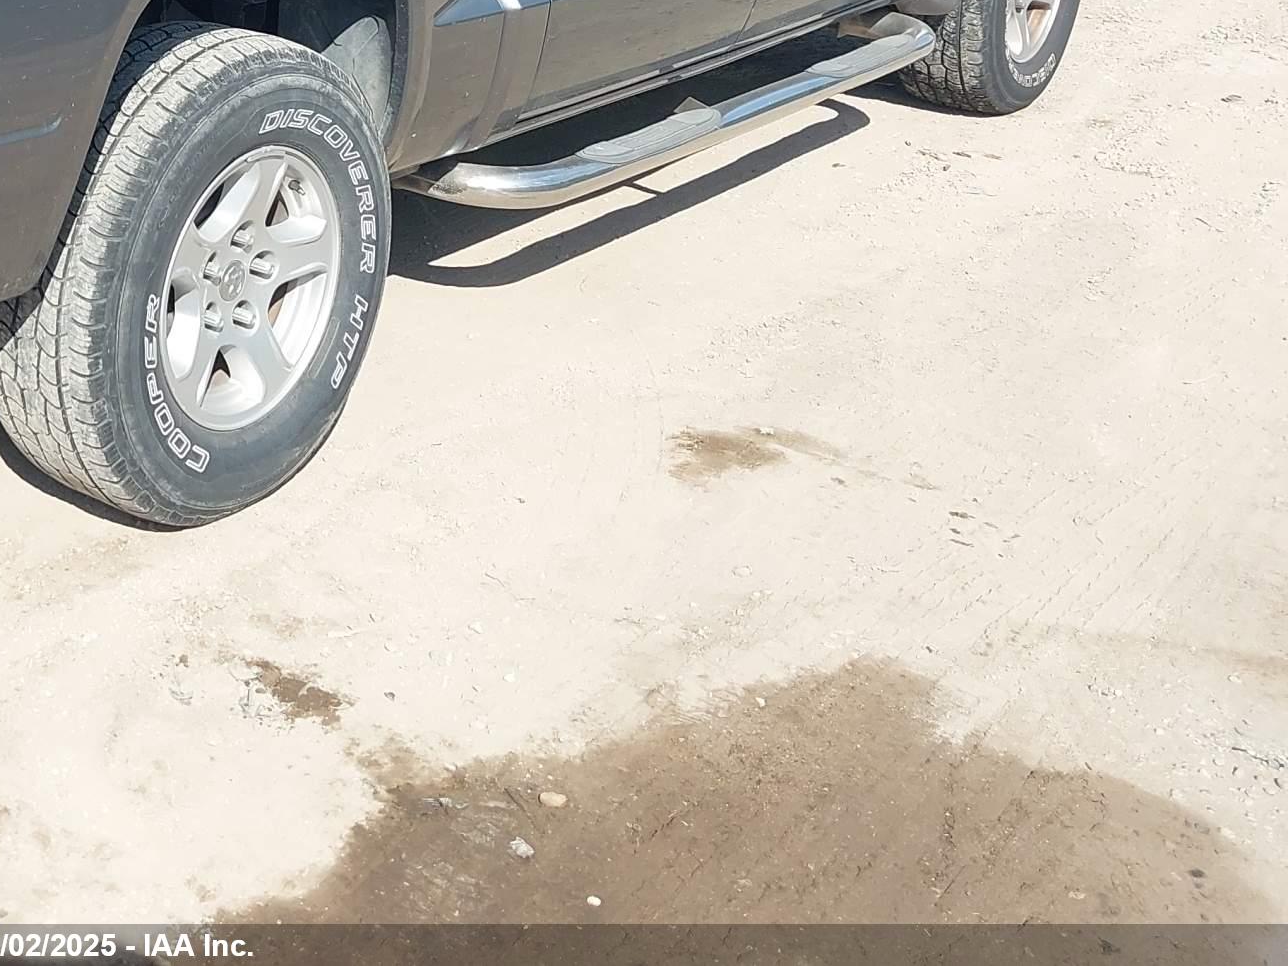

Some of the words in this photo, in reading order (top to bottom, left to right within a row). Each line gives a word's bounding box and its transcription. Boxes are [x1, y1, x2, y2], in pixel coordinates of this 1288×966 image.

[258, 107, 378, 275] DISCOVERER
[330, 293, 370, 391] HTP
[144, 293, 210, 474] COOPER
